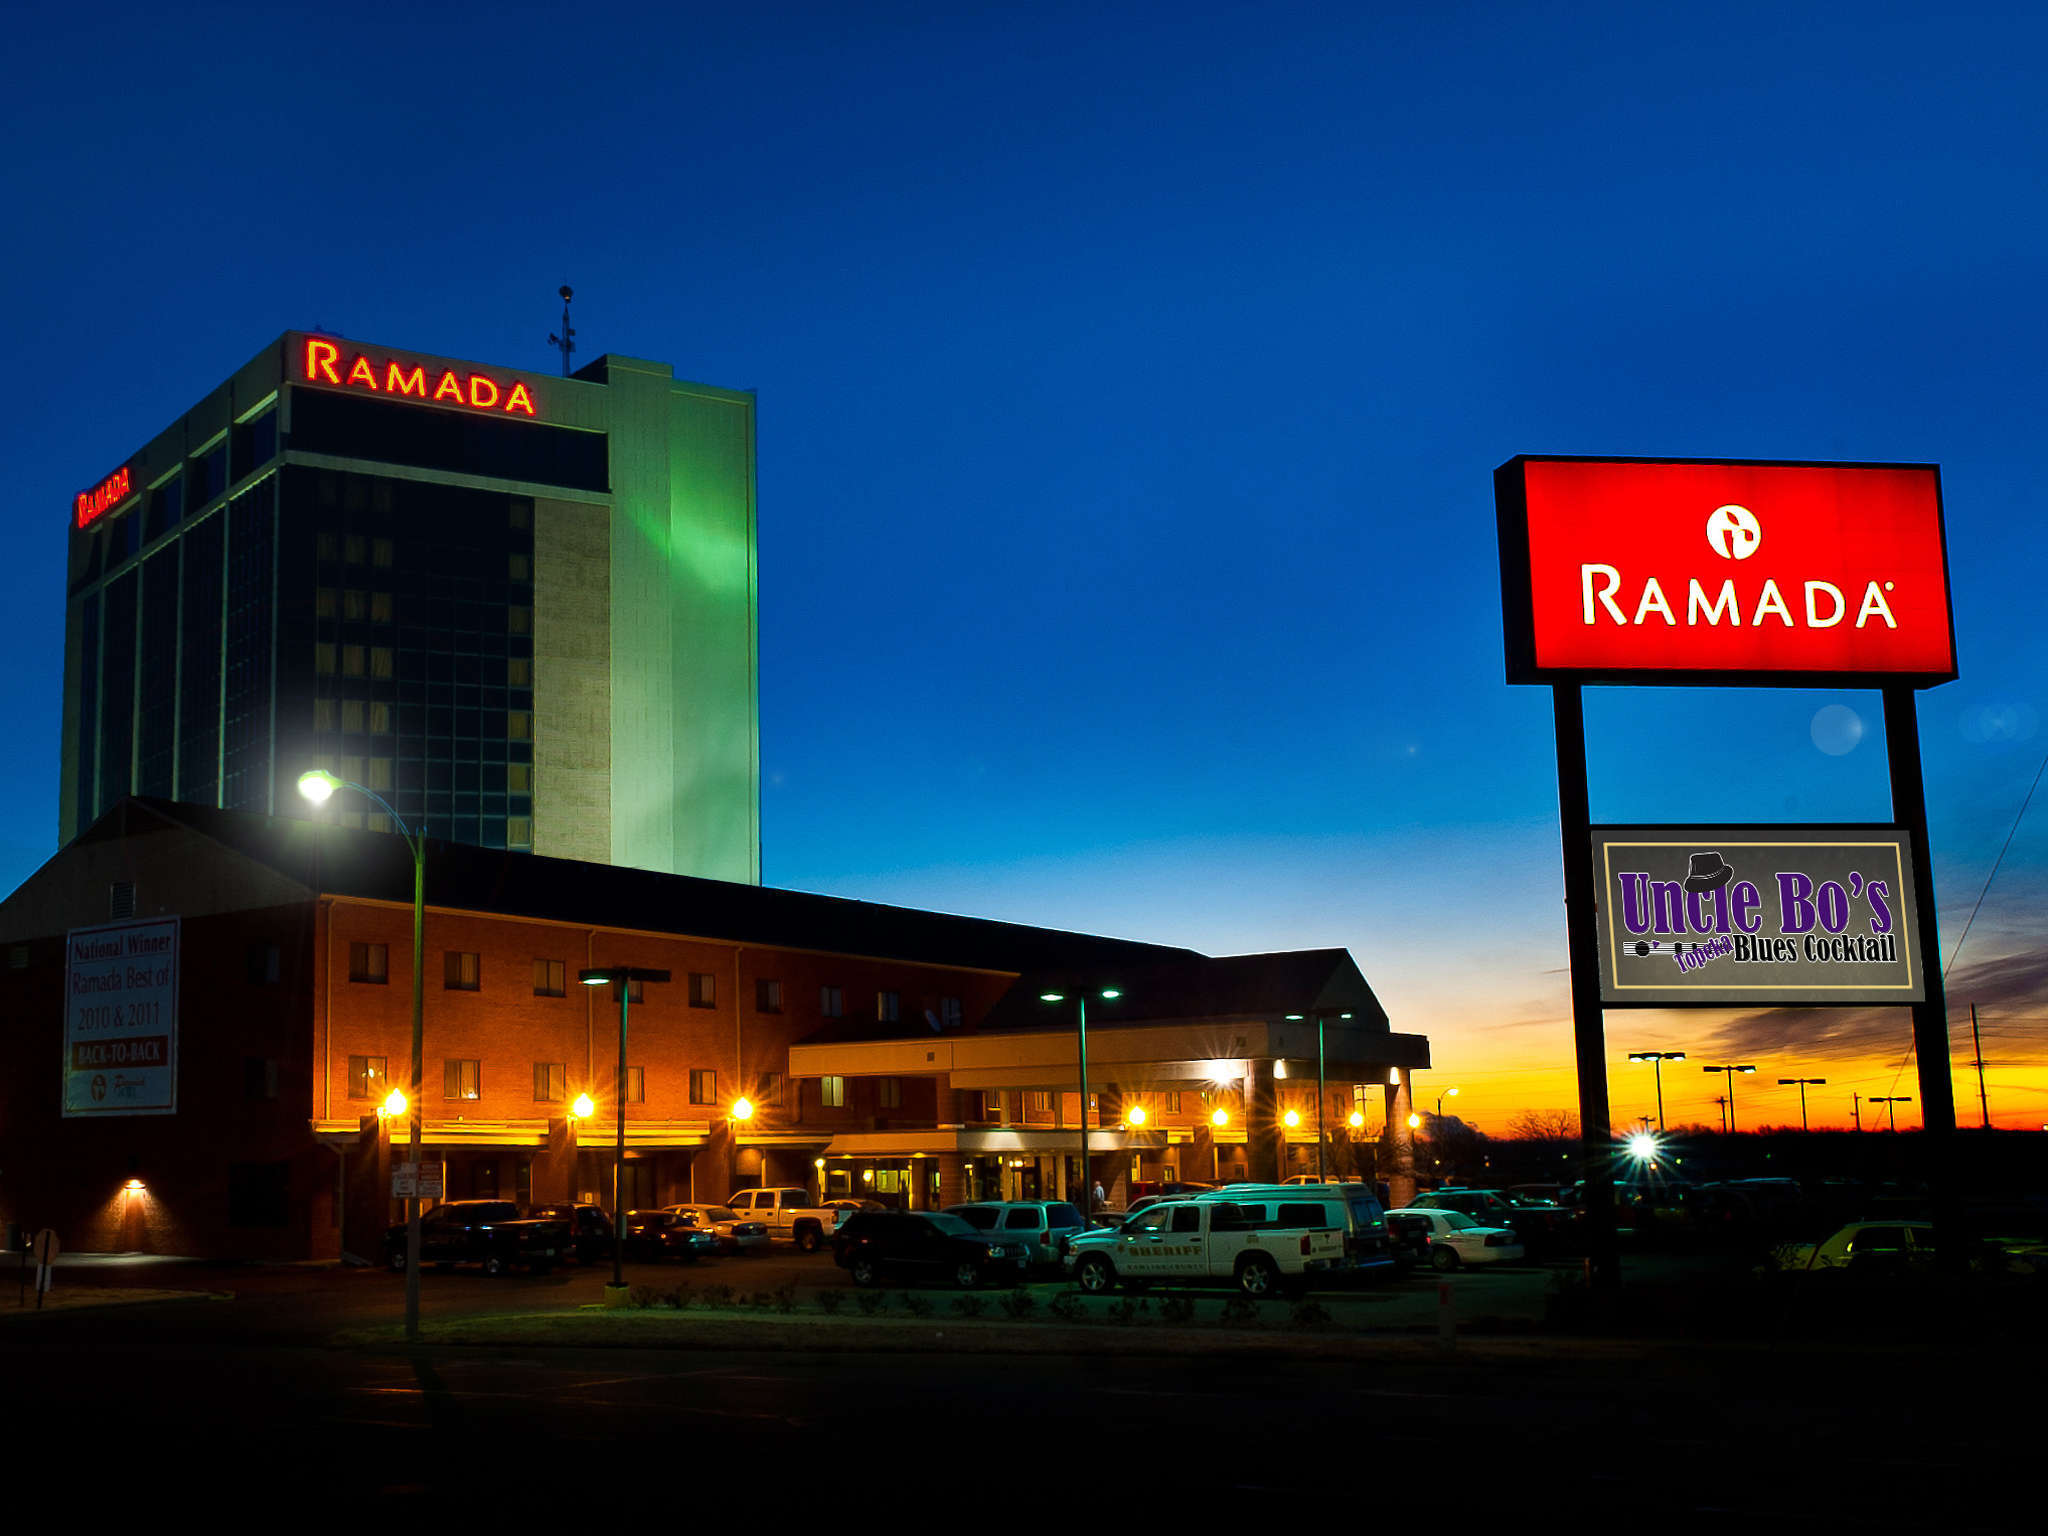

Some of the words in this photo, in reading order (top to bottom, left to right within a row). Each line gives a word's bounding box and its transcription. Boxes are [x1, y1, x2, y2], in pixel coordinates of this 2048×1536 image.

[305, 338, 536, 416] RAMADA
[1581, 563, 1898, 629] RAMADA
[1618, 872, 1763, 934] Uncle
[1775, 871, 1893, 934] Bo's
[75, 935, 123, 960] National
[128, 933, 171, 954] Winner
[1673, 933, 1734, 974] Topeka
[1733, 934, 1798, 963] Blues
[1804, 933, 1898, 963] Cocktail
[73, 967, 122, 995] Ramada
[126, 965, 153, 990] Best
[156, 963, 170, 987] of
[78, 1005, 110, 1031] 2010
[113, 1003, 124, 1027] &
[128, 1000, 160, 1027] 2011
[77, 1041, 161, 1066] BACK-TO-BACK
[1129, 1246, 1202, 1257] SHERIFF
